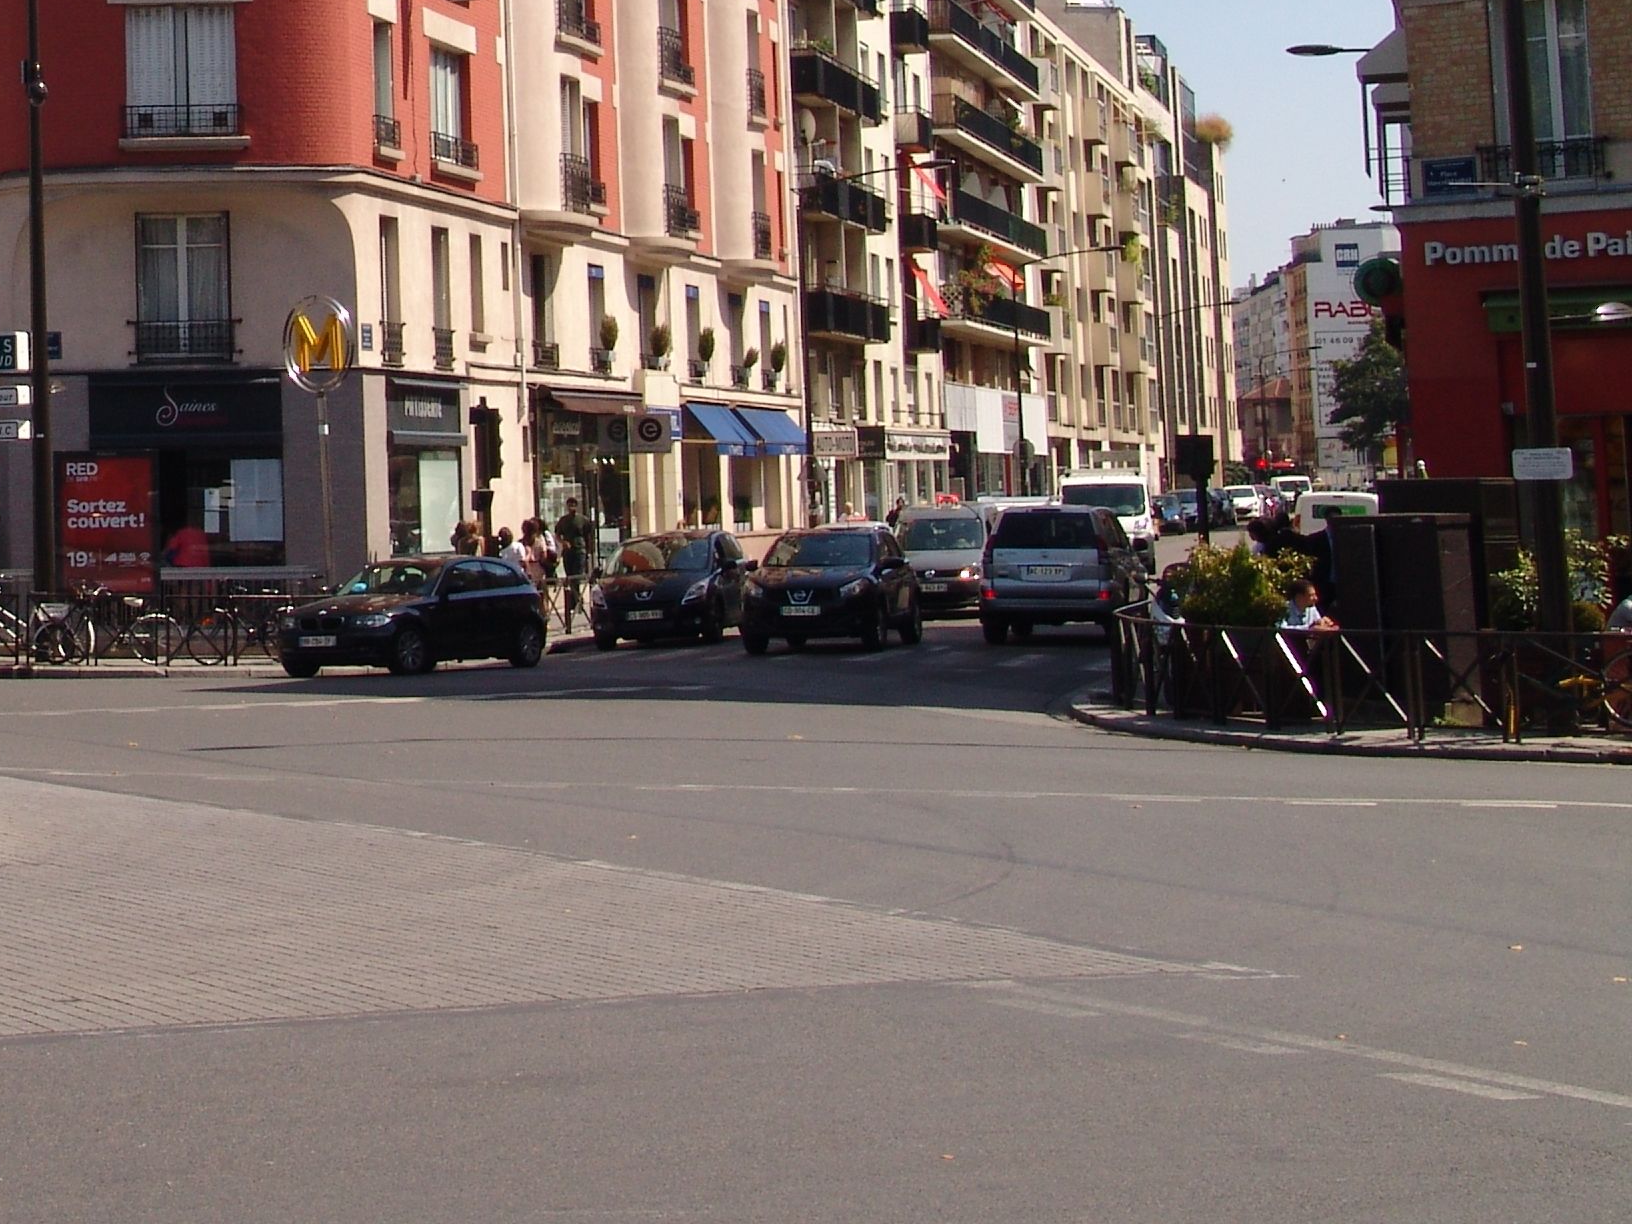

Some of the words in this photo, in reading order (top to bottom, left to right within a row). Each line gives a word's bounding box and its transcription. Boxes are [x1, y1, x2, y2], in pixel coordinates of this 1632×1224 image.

[1424, 241, 1517, 266] Pomm
[1544, 234, 1581, 259] de
[66, 462, 98, 476] RED
[67, 498, 127, 513] Sortez
